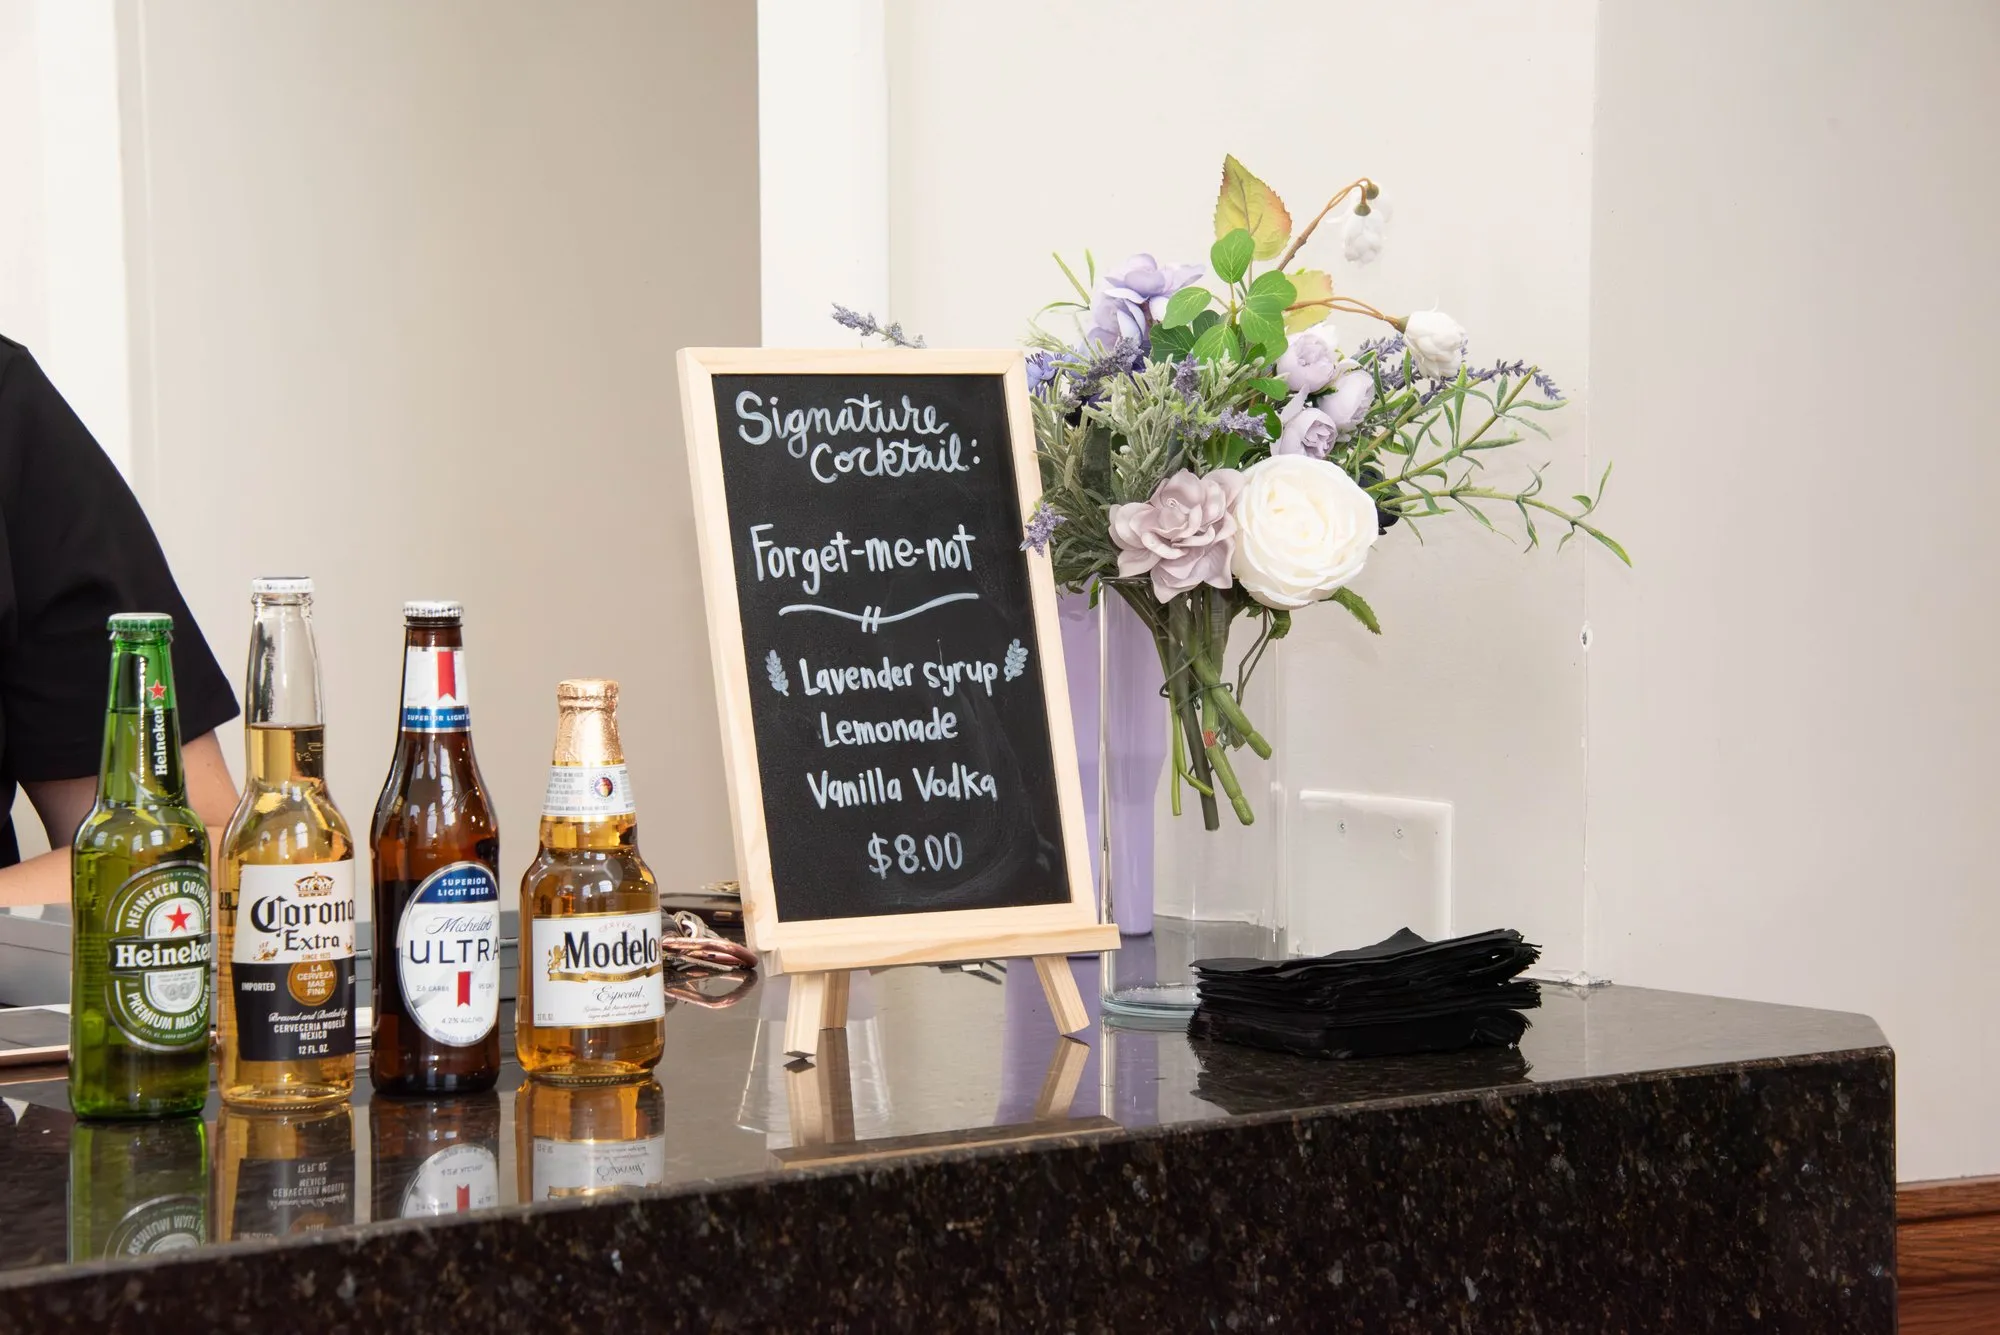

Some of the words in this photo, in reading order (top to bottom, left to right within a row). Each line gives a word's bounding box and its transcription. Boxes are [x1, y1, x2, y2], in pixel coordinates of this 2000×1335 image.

[736, 391, 949, 459] Signature
[810, 433, 980, 483] Cocktail:
[750, 524, 976, 595] Forget-me-not
[799, 656, 914, 696] Lavender
[923, 661, 998, 697] syrup
[821, 707, 958, 748] Lemonade
[153, 705, 168, 776] Heineken
[807, 768, 902, 809] Vanilla
[913, 762, 998, 803] Vodka
[868, 832, 963, 880] $8.00
[438, 888, 467, 896] LIGHT
[470, 887, 489, 895] BEER
[442, 877, 486, 886] SUPERIOR
[126, 881, 179, 929] HEINEKEN
[426, 916, 493, 935] Michelob
[284, 929, 340, 951] Extra
[564, 928, 657, 969] Modelo
[297, 971, 335, 983] CERVEZA
[310, 964, 323, 973] LA
[241, 982, 276, 992] IMPORTED
[306, 988, 326, 997] FINA
[593, 985, 643, 1004] Especial
[127, 992, 172, 1030] PREMIUM
[175, 1011, 198, 1030] MALT
[268, 1012, 303, 1023] Brewed
[302, 1011, 318, 1021] and
[274, 1022, 321, 1033] CERVECERIA
[322, 1018, 346, 1030] MODELO
[300, 1031, 327, 1041] MEXICO
[298, 1044, 306, 1055] 12
